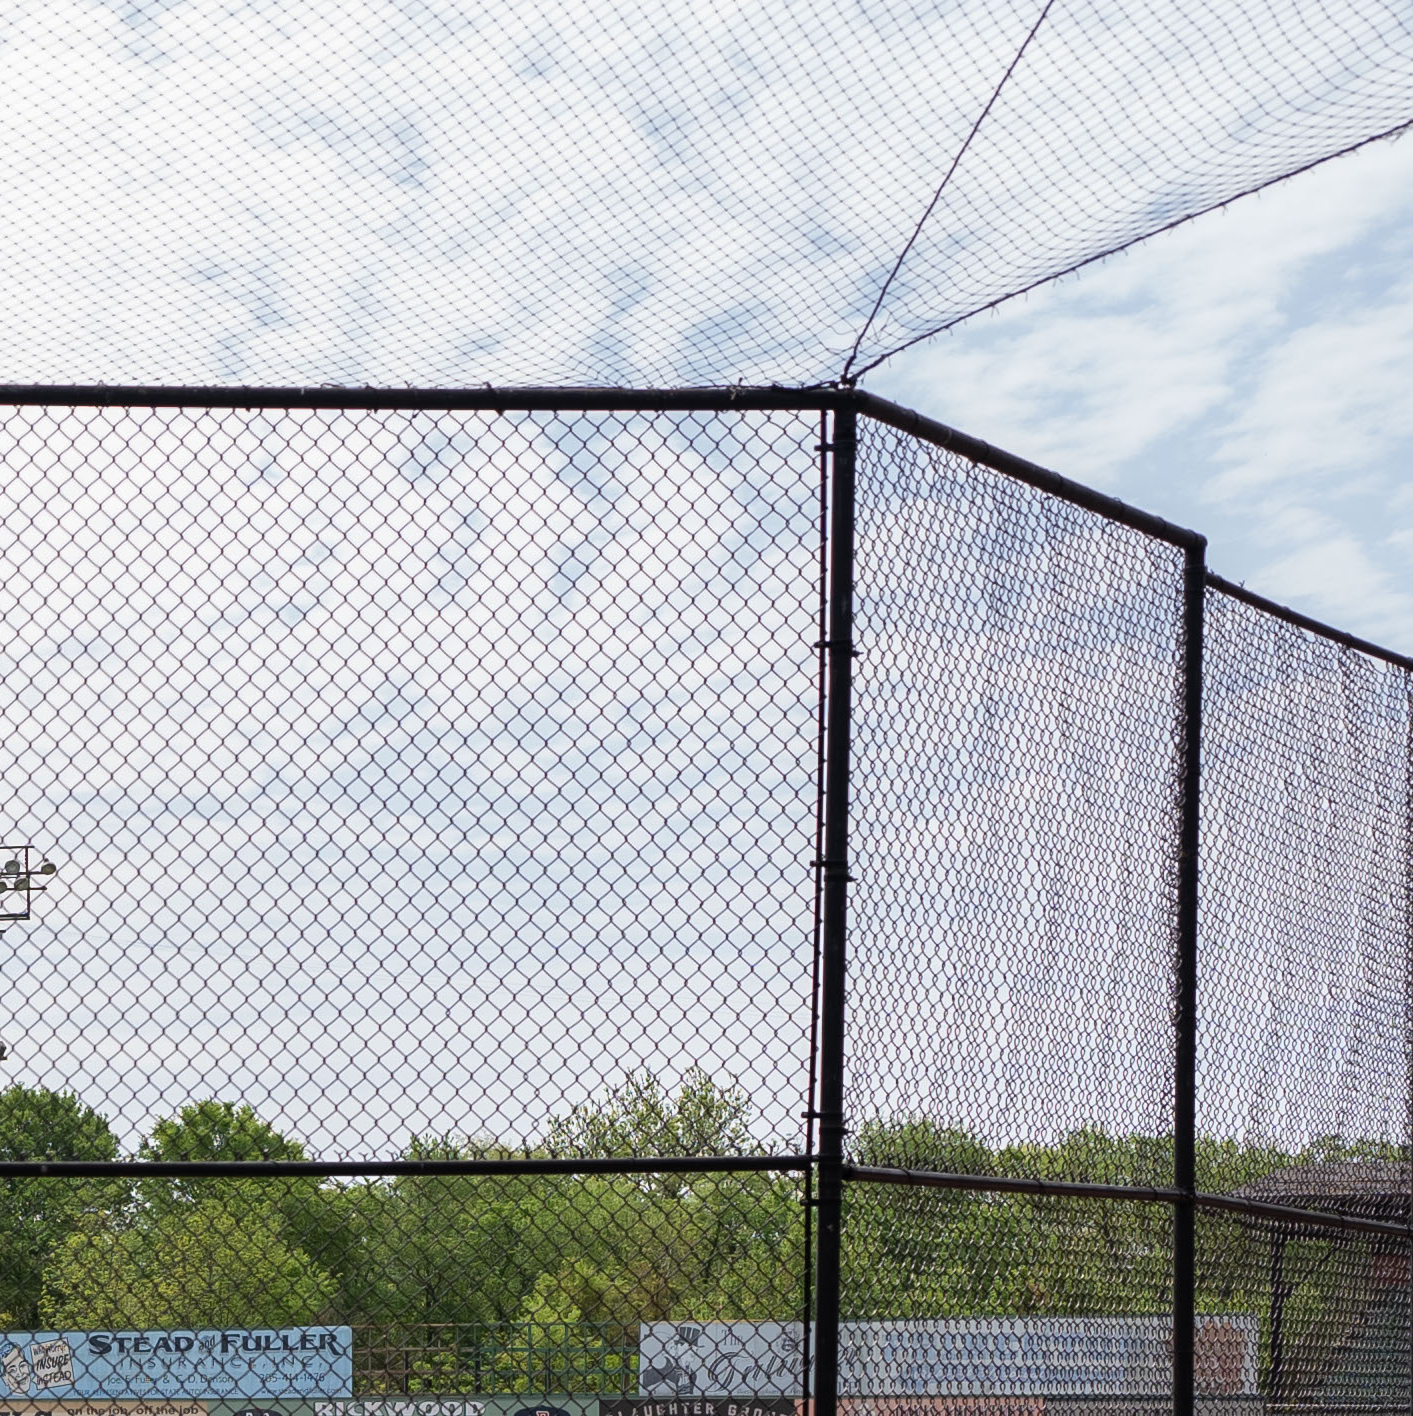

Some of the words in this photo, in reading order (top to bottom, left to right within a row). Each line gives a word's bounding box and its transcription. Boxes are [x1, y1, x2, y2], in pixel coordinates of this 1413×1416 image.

[88, 1334, 195, 1355] STEAD
[198, 1334, 216, 1351] and
[220, 1333, 345, 1357] FULLER
[36, 1353, 70, 1371] INSURE
[67, 1408, 83, 1416] on
[86, 1405, 105, 1416] the
[136, 1405, 154, 1416] off
[155, 1405, 176, 1416] the
